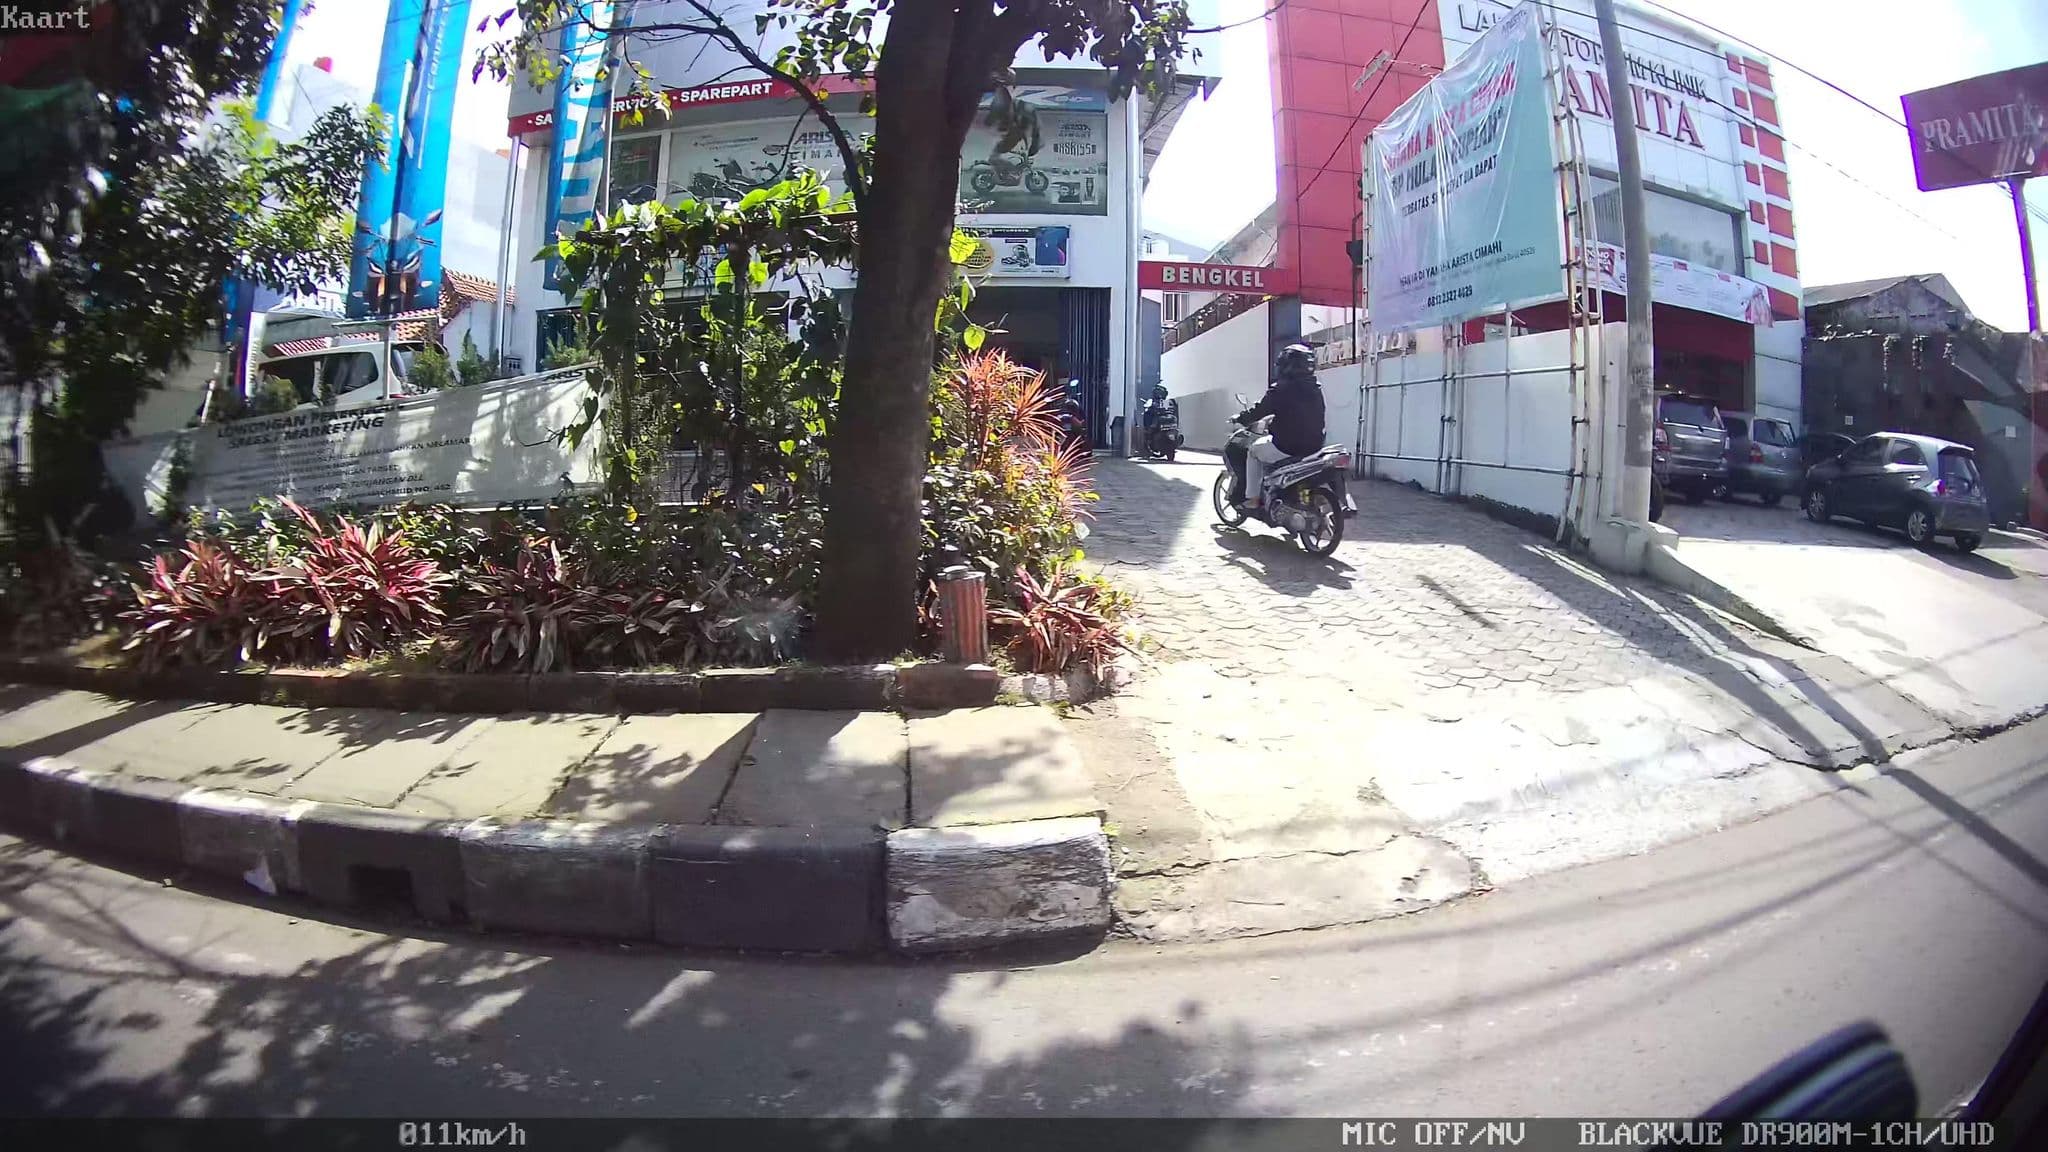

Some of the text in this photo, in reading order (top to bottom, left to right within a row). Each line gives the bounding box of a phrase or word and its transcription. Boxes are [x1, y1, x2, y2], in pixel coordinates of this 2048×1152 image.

[680, 82, 774, 103] SPAREPART
[1919, 103, 2040, 153] PRAMITA
[1474, 153, 1498, 179] DAPAT
[1474, 239, 1503, 260] CIMAHI
[1162, 266, 1264, 288] BENGKEL
[284, 416, 385, 441] MARKETING
